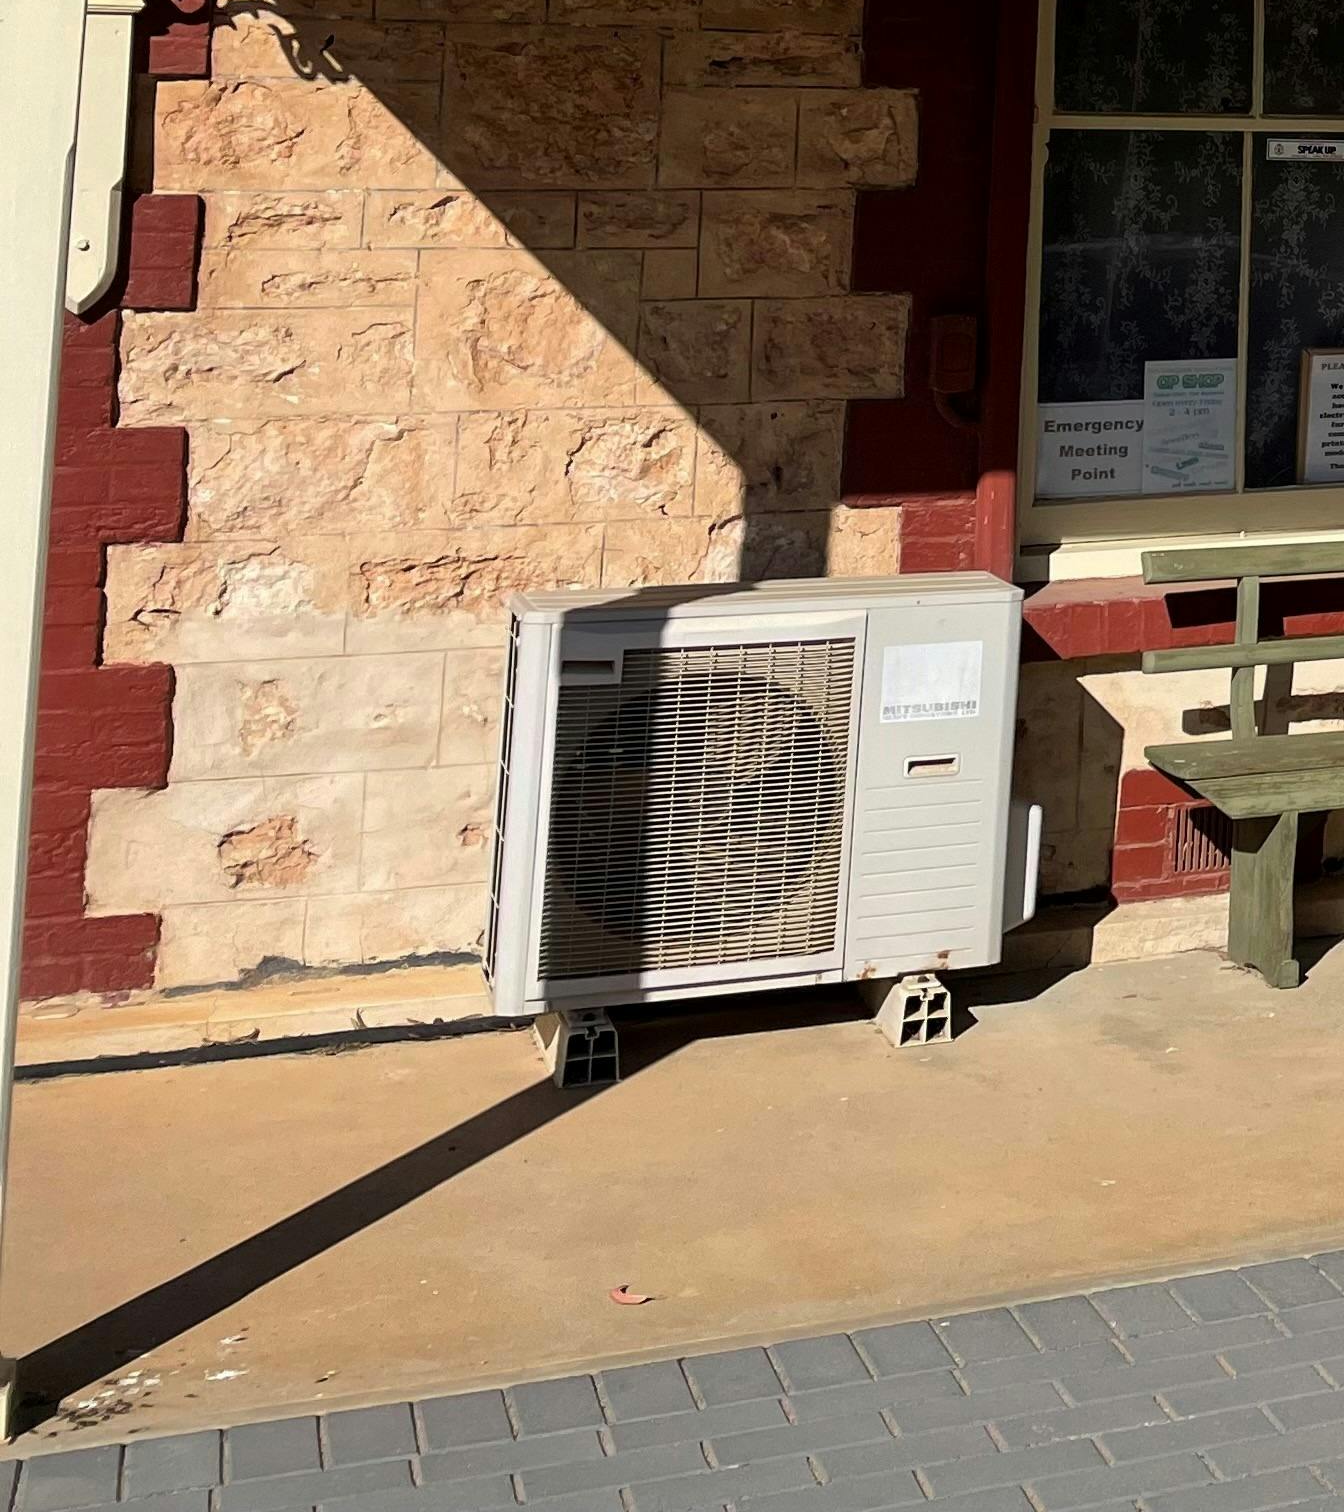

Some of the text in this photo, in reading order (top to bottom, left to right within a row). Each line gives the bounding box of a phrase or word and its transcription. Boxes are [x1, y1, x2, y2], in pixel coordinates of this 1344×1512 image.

[1297, 145, 1337, 154] SPEAK UP
[1157, 373, 1224, 389] OP SHOP
[1044, 419, 1144, 434] Emergency
[1059, 444, 1129, 458] Meeting
[1071, 468, 1115, 481] Point
[883, 700, 977, 715] MITSUBISHI
